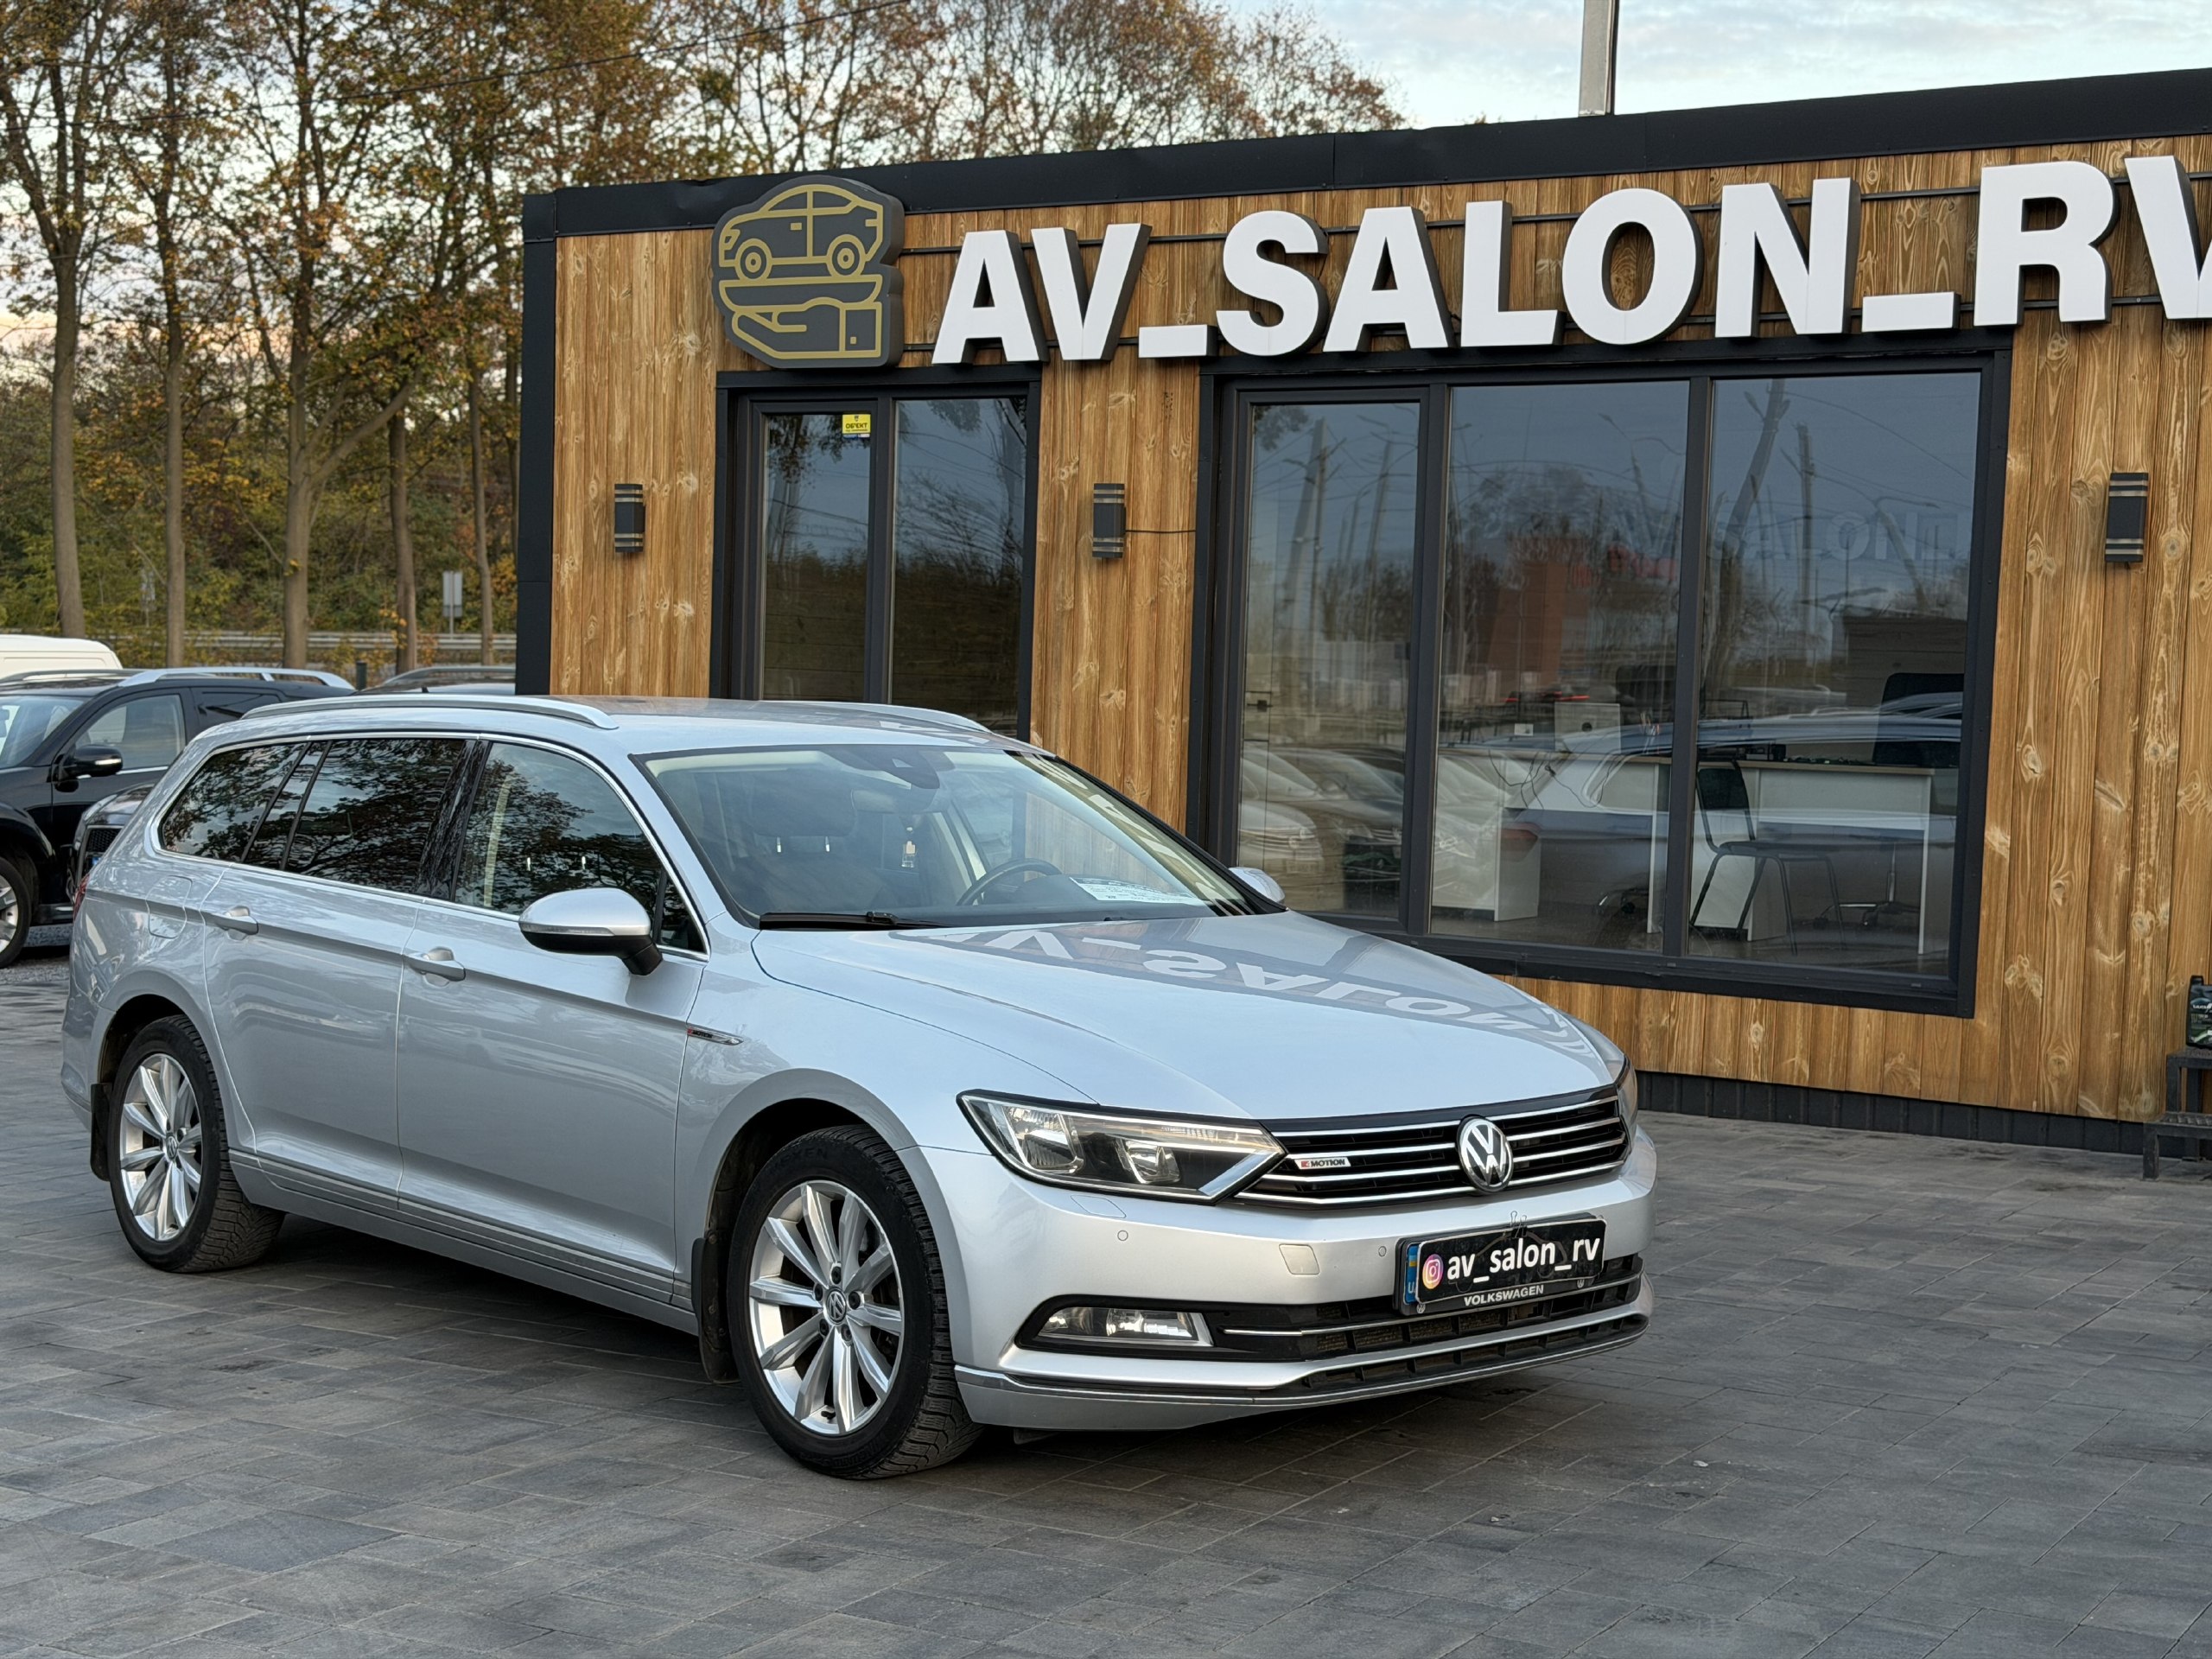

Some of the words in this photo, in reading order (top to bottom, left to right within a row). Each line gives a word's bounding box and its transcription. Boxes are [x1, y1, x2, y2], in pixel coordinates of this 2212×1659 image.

[931, 156, 2212, 364] AV_SALON_RV
[1447, 1238, 1600, 1283] av_salon_rv
[1464, 1284, 1544, 1306] VOLKSWAGEN
